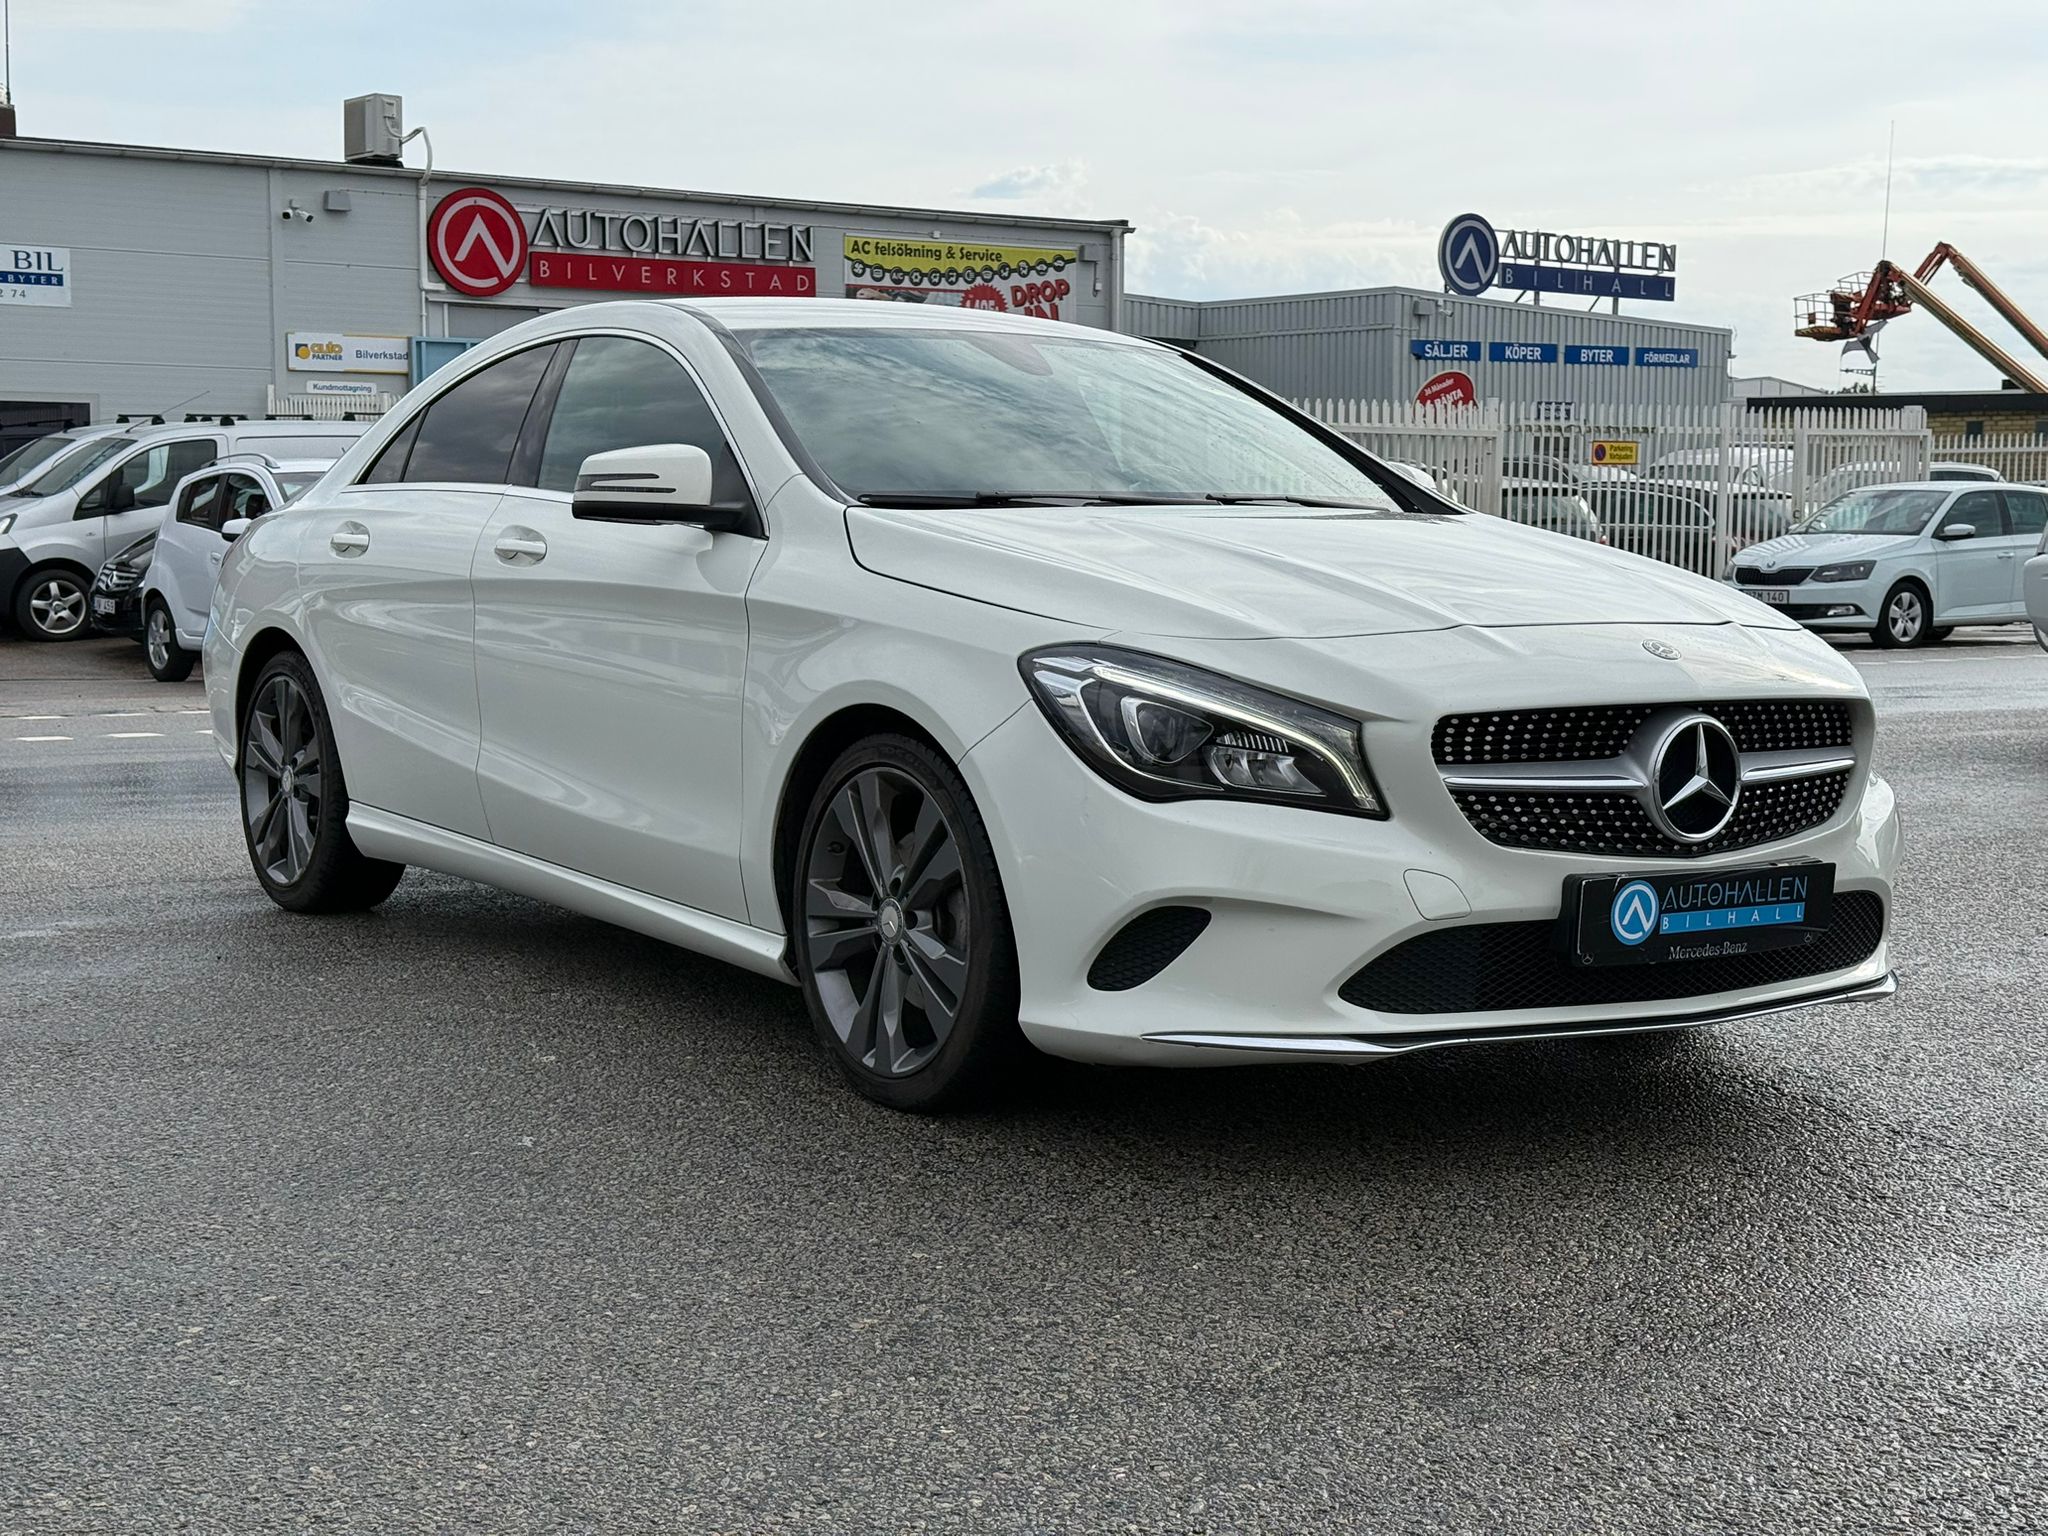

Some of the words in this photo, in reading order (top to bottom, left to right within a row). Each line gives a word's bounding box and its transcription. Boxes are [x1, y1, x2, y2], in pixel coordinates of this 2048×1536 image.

[531, 207, 814, 262] AUTOHALLEN
[10, 249, 64, 272] BIL
[851, 240, 870, 255] AC
[875, 241, 942, 260] felsökning
[946, 246, 955, 260] &
[960, 247, 1003, 262] Service
[1500, 230, 1677, 272] AUTOHALLEN
[539, 259, 810, 292] BILVERKSTAD
[1505, 267, 1671, 298] BILHALL
[11, 289, 26, 298] 74
[1010, 279, 1070, 307] DROP
[1024, 303, 1059, 320] IN
[355, 350, 408, 361] Bilverkstad
[1424, 341, 1468, 359] SÄLJER
[1505, 343, 1542, 360] KÖPER
[1580, 349, 1614, 363] BYTER
[1643, 351, 1690, 364] FÖRMEDLAR
[313, 383, 372, 393] Kundmottagning
[1767, 592, 1784, 602] 140
[1662, 876, 1808, 911] AUTOHALLEN
[1662, 905, 1803, 930] BILHALL
[1668, 940, 1748, 959] Mercedes-Benz
